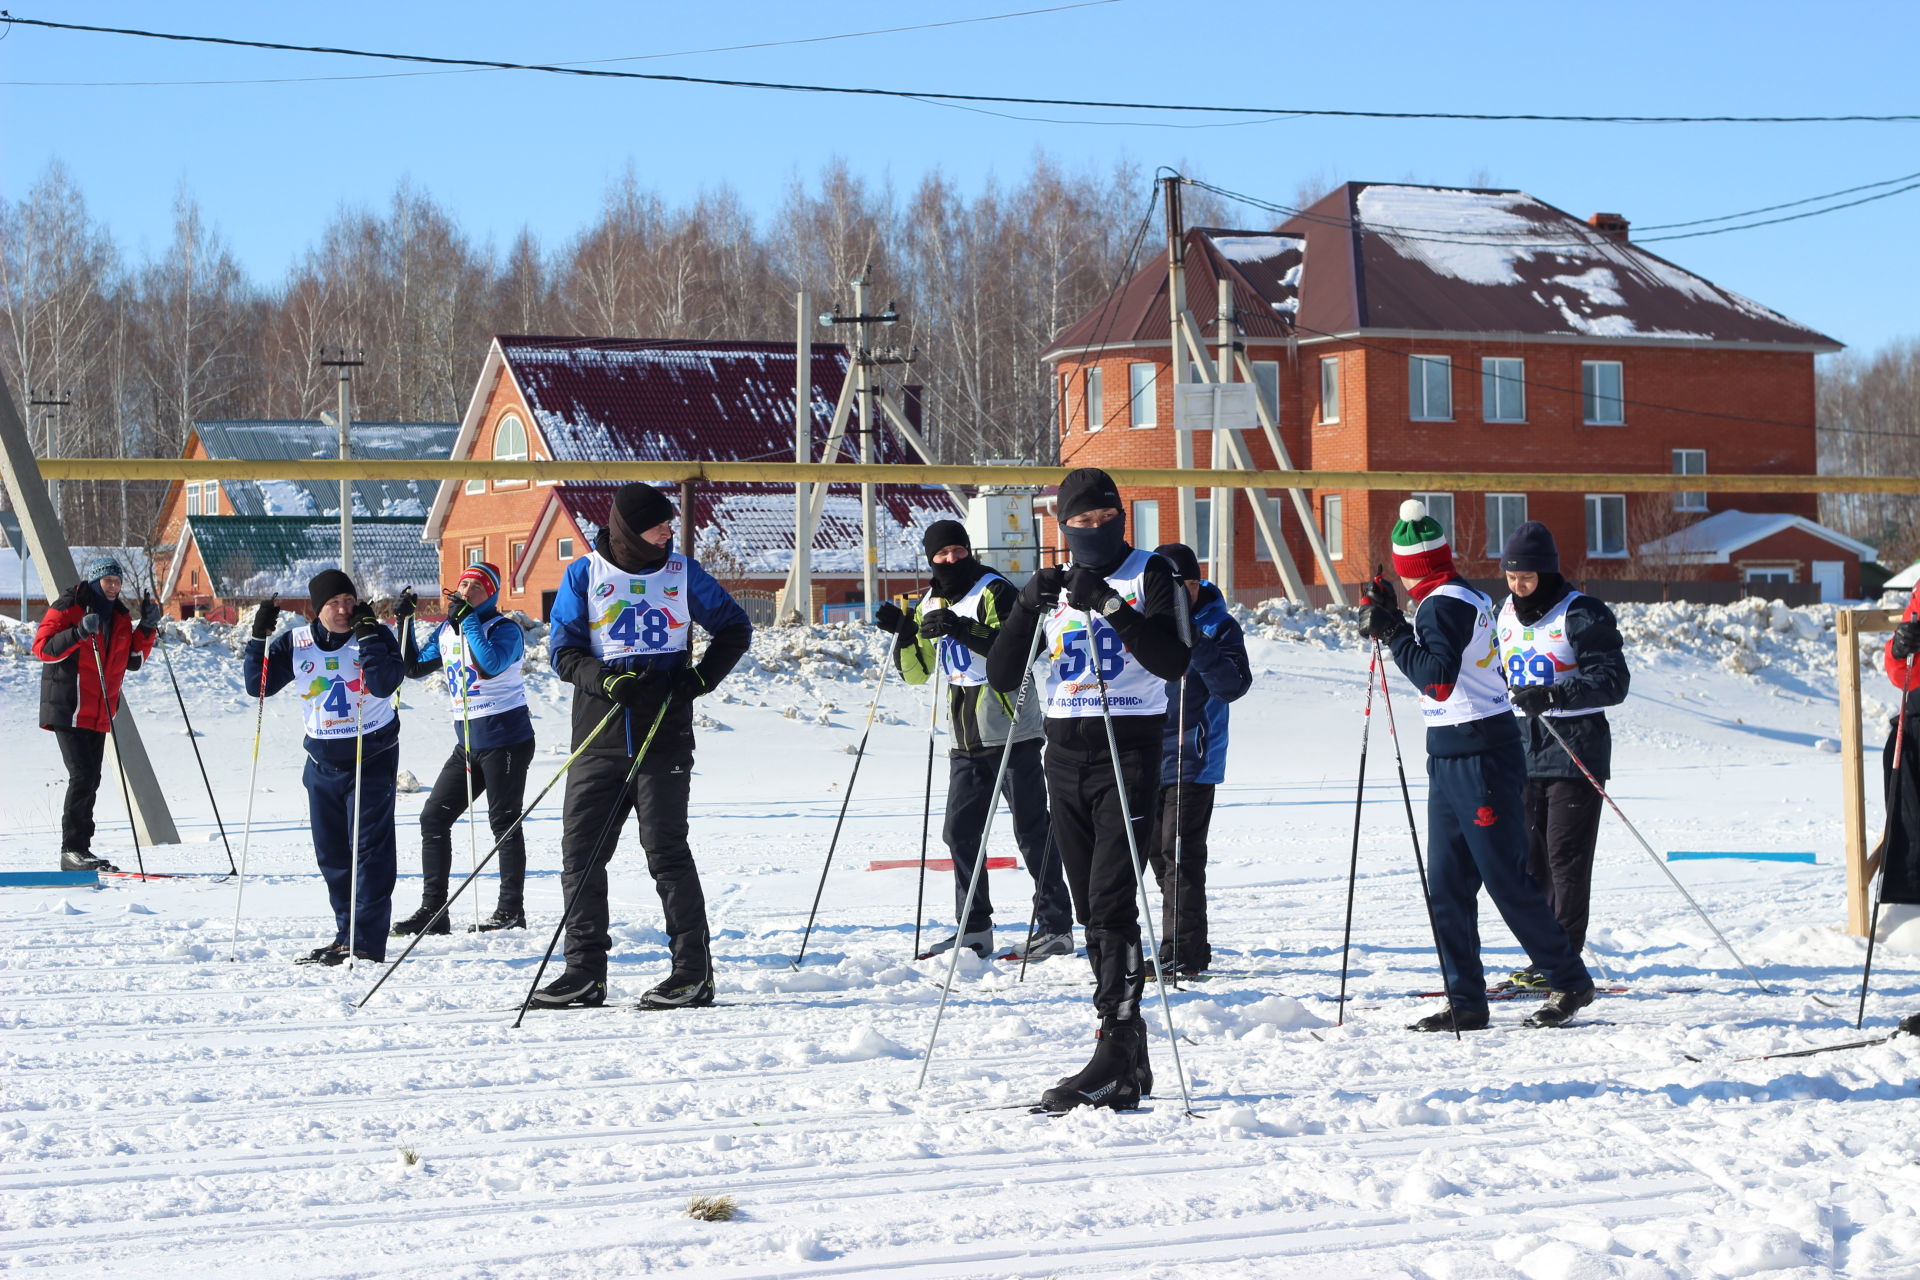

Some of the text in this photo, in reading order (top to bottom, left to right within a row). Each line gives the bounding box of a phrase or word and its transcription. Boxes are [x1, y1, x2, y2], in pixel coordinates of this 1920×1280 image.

[608, 608, 668, 648] 48
[1060, 628, 1124, 681] 58
[1508, 655, 1554, 686] 89
[446, 666, 480, 697] 82
[324, 682, 351, 717] 4
[1055, 696, 1143, 707] «ГАЗСТРОЙЕРВИС»
